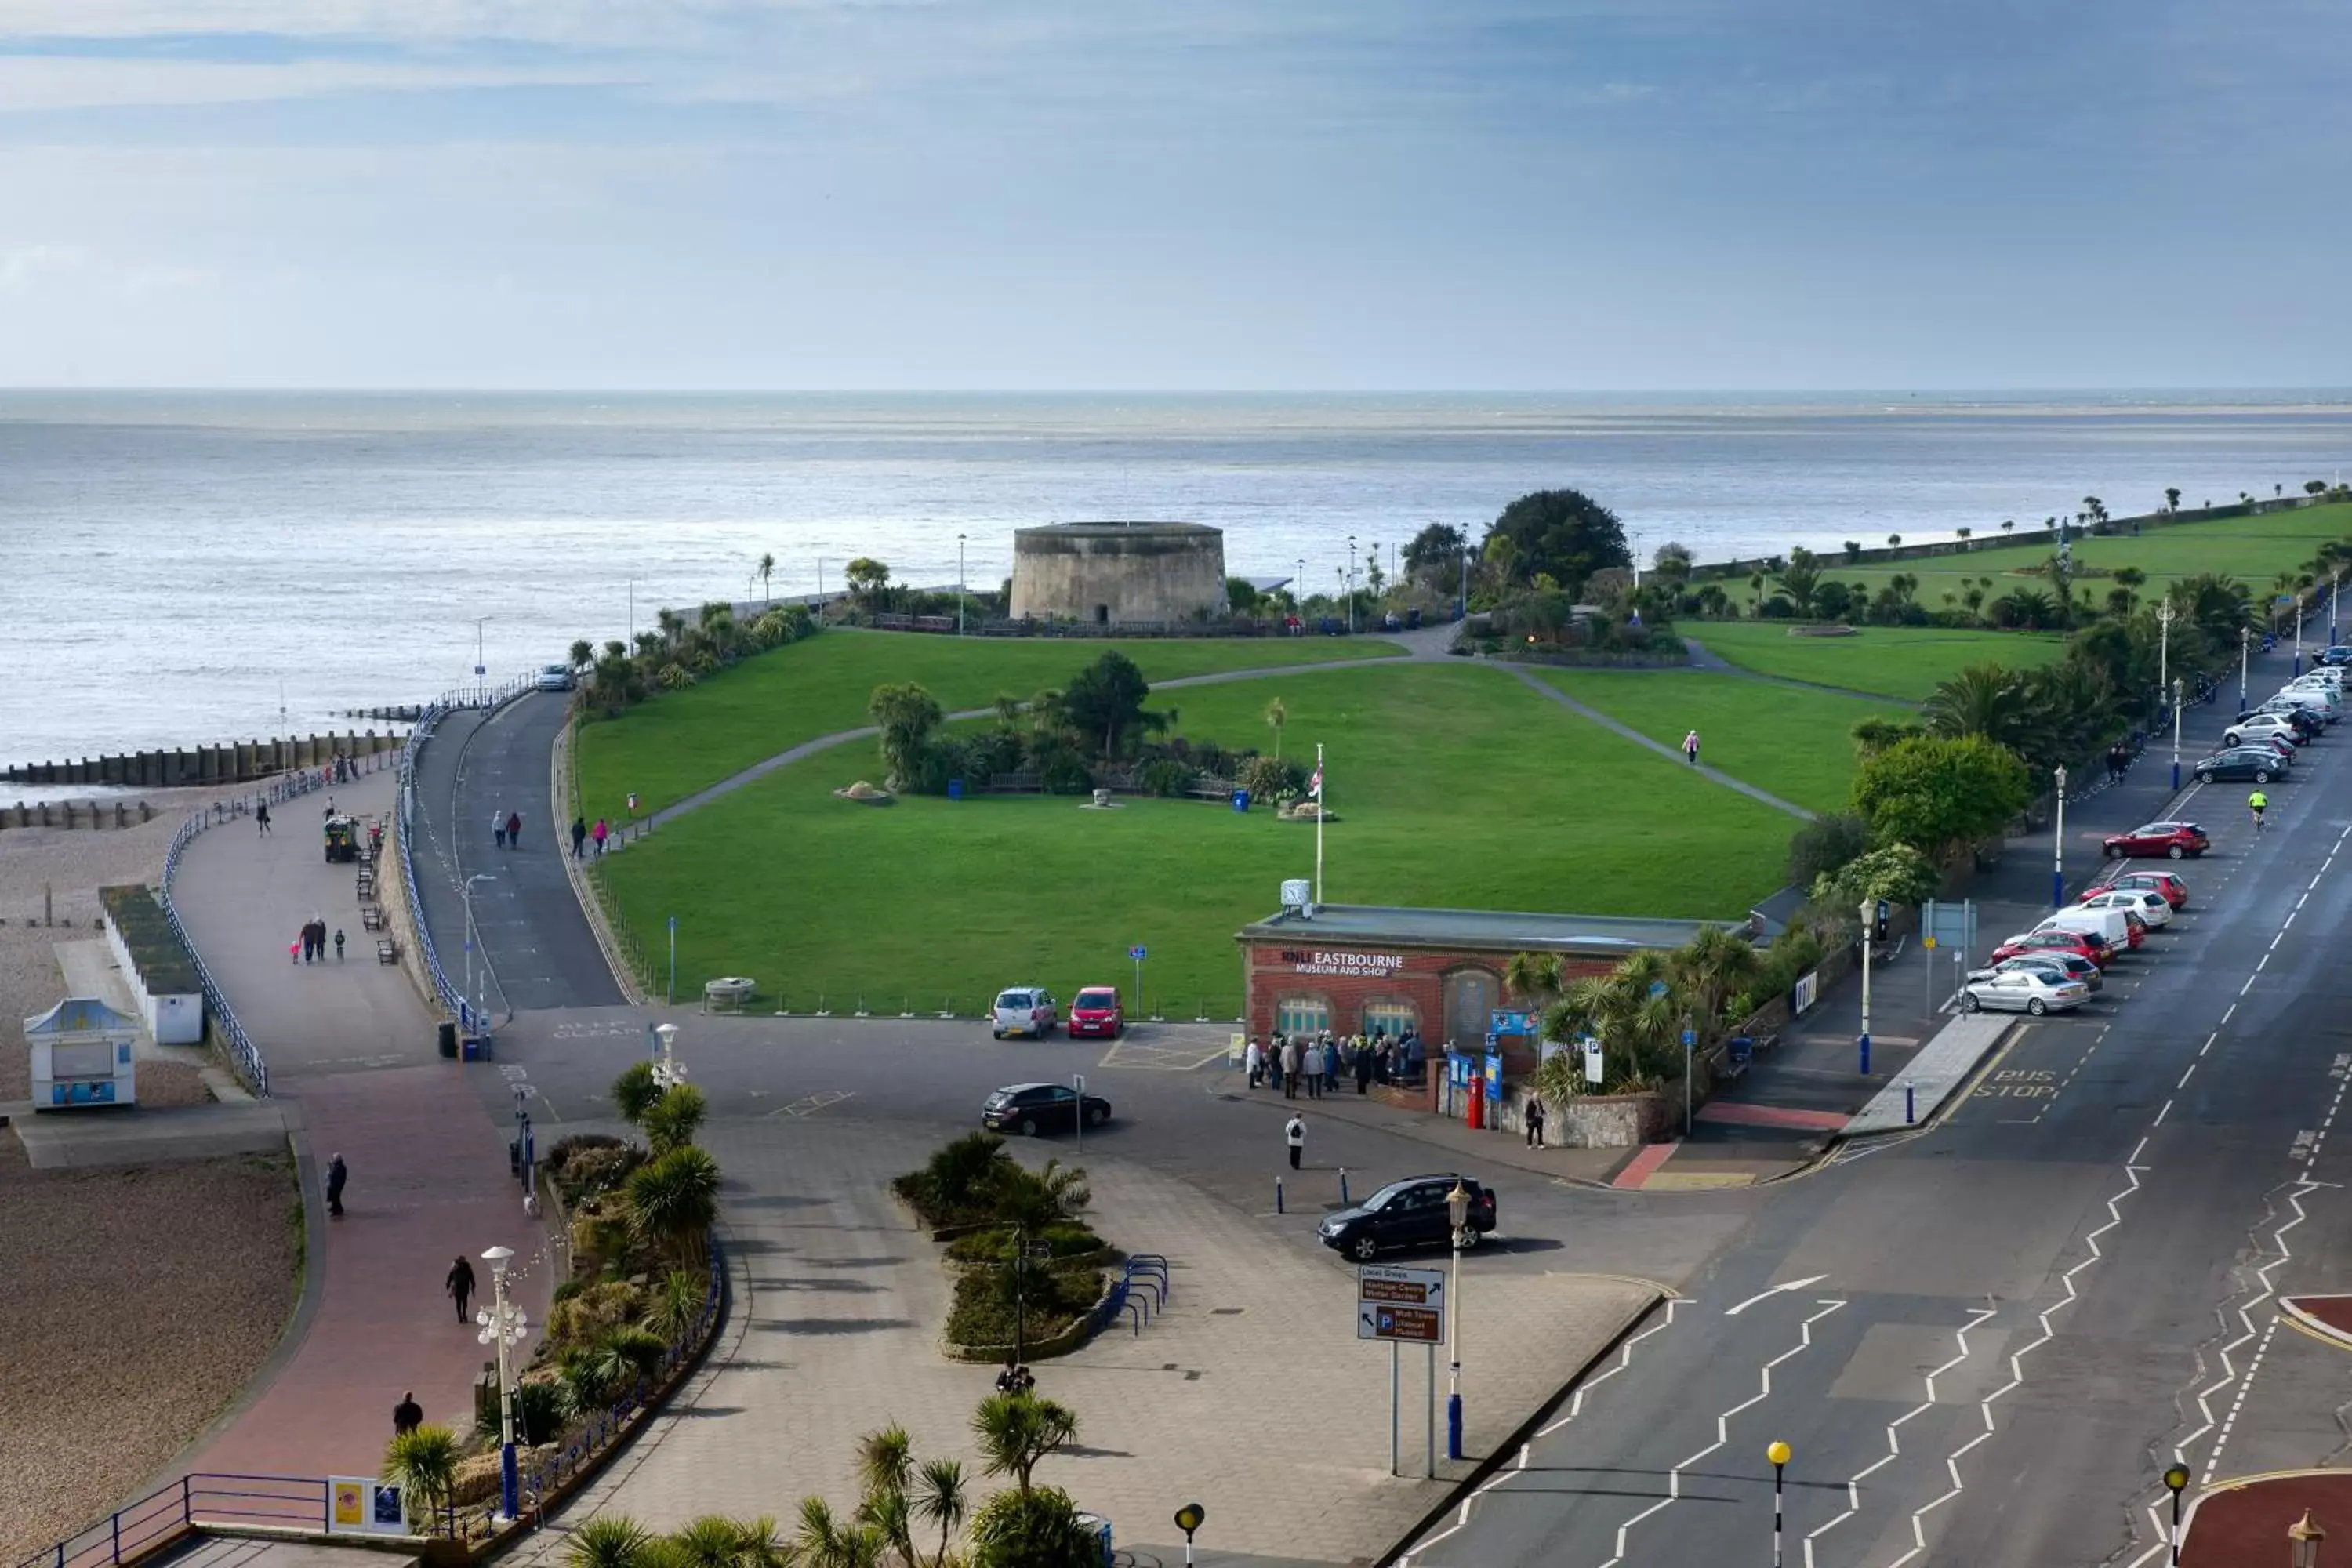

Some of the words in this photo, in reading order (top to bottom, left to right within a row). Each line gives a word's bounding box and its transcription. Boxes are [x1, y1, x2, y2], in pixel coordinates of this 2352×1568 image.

[1314, 953, 1403, 969] EASTBOURNE
[1295, 964, 1338, 975] MUSEUM
[1339, 966, 1360, 975] AND
[1362, 967, 1388, 977] SHOP
[1994, 1069, 2057, 1082] BUS
[1973, 1085, 2056, 1098] STOP
[1362, 1268, 1382, 1277] Local
[1384, 1269, 1408, 1279] Shops
